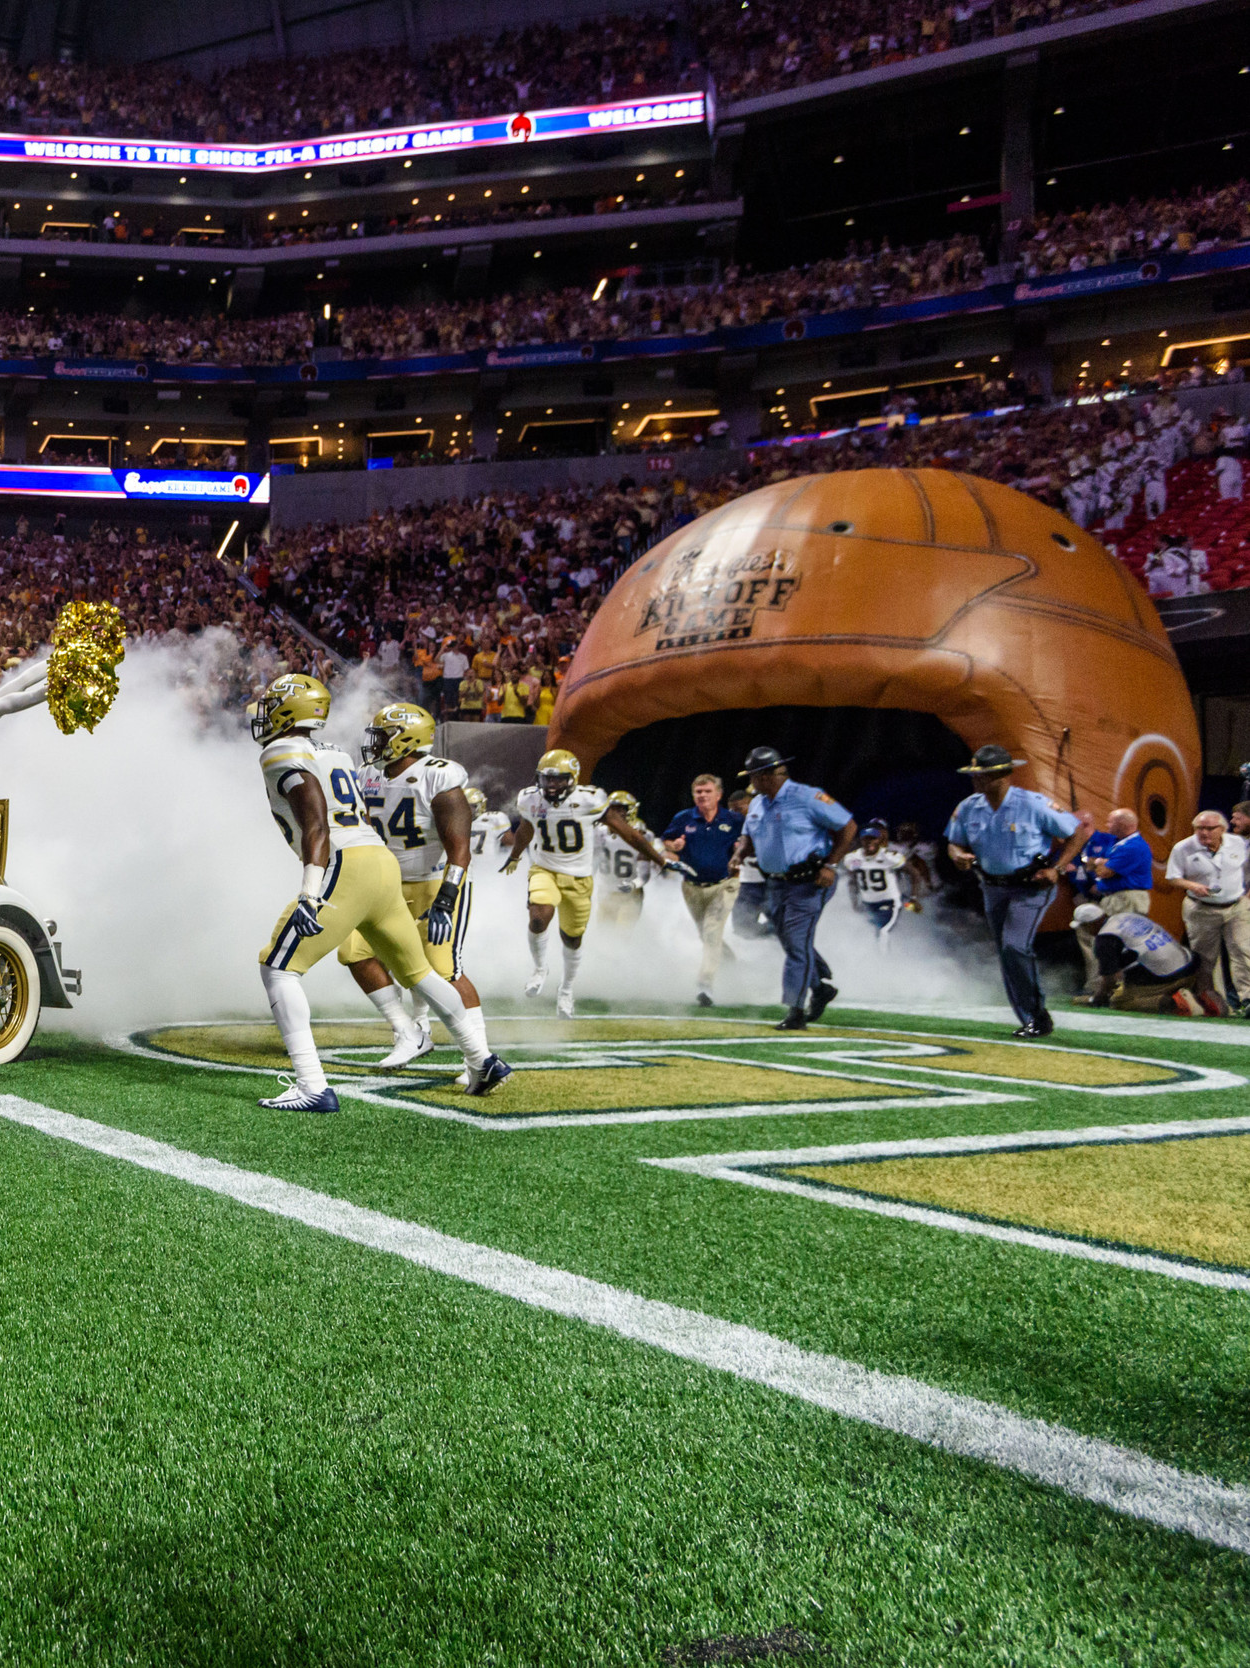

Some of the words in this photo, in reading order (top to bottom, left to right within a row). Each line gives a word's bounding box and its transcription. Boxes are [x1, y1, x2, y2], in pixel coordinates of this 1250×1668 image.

[588, 100, 704, 128] WELCOME
[24, 142, 121, 160] WELCOME
[124, 147, 150, 161] TO
[154, 148, 191, 163] THE
[195, 146, 316, 168] CHICK-FIL-A
[319, 134, 409, 159] KICKOFF
[412, 127, 474, 148] GAME
[272, 675, 305, 697] GT
[386, 708, 420, 725] GT
[363, 796, 427, 850] 54
[536, 819, 584, 854] 10
